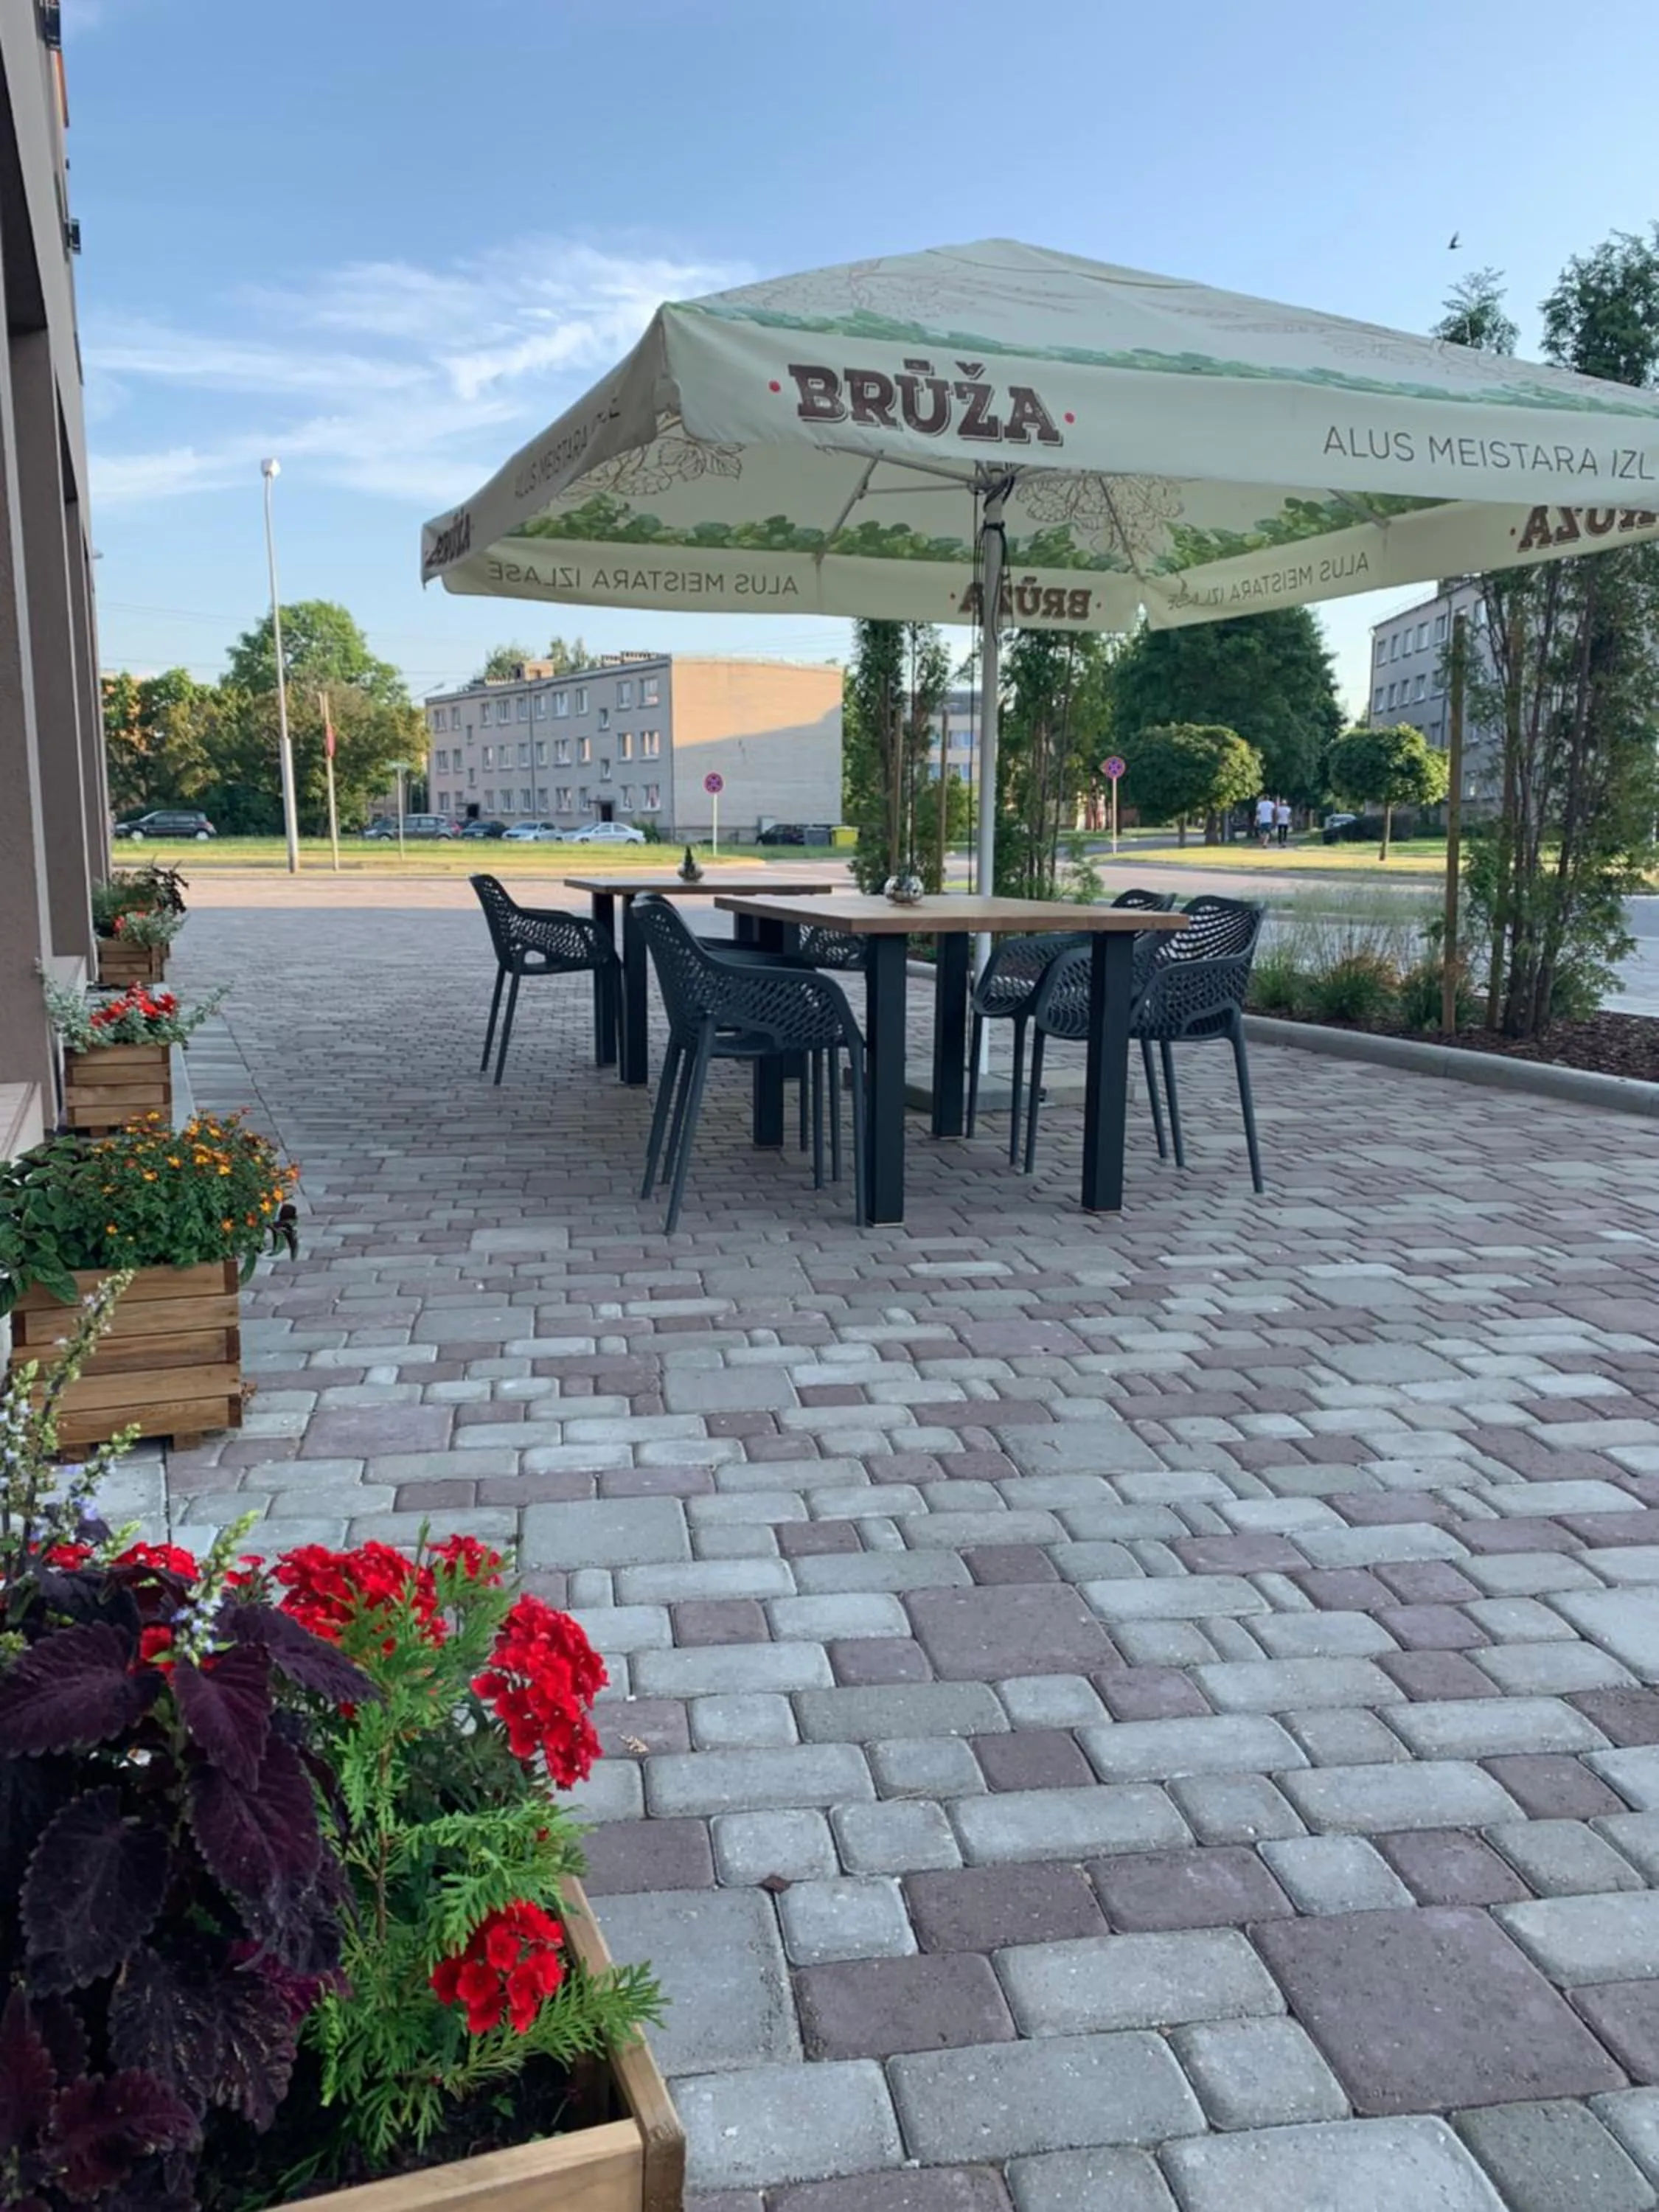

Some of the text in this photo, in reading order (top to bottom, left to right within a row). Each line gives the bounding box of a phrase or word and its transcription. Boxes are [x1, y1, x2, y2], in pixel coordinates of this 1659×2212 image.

[787, 358, 1063, 447] BRŪŽA
[1324, 425, 1656, 480] ALUS MEISTARA IZL
